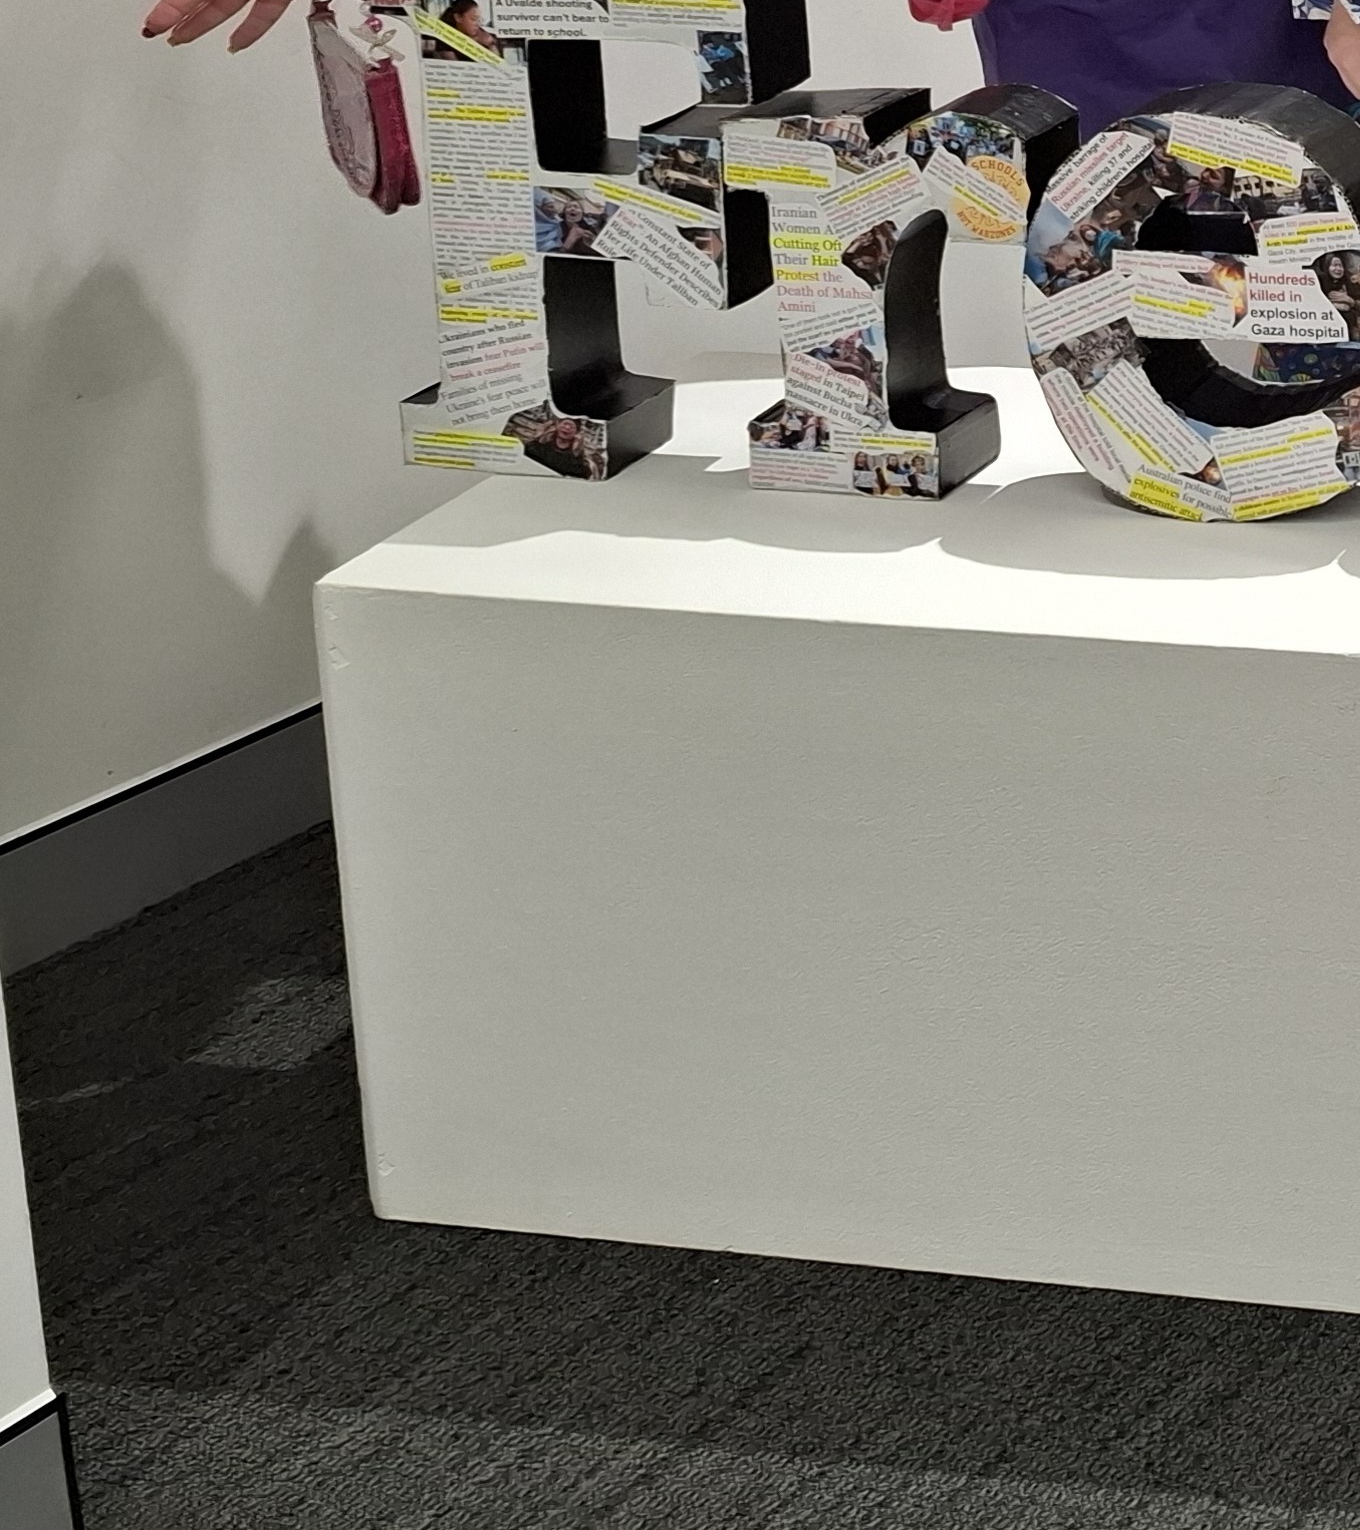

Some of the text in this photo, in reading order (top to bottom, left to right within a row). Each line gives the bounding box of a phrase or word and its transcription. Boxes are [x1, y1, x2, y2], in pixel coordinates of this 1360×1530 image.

[506, 0, 542, 7] Uvalde
[545, 0, 592, 10] shooting
[497, 14, 609, 23] survivor can't bear to
[499, 28, 530, 36] return
[534, 28, 544, 36] to
[1073, 142, 1099, 167] barrage
[1099, 134, 1108, 144] of
[1052, 132, 1129, 203] Russian missiles target
[1088, 166, 1111, 186] killing
[1108, 157, 1118, 167] 37
[1120, 144, 1133, 159] and
[971, 160, 1025, 187] SCHOOLS
[772, 207, 817, 218] Iranian
[1070, 196, 1098, 220] striking
[772, 222, 821, 234] Women
[957, 211, 1017, 239] NOT WARZONES
[637, 213, 712, 270] Constant State of
[773, 238, 820, 253] Cutting
[610, 221, 719, 308] Rights Defender Describes
[645, 233, 722, 296] An Afghan Human
[774, 254, 839, 266] Their Hair
[603, 230, 698, 306] Her Life Under Taliban
[776, 270, 843, 282] Protest the
[1248, 272, 1315, 286] Hundreds
[777, 286, 873, 299] Death of Mahsa
[1250, 290, 1302, 302] killed in
[778, 301, 815, 312] Amini
[1251, 308, 1334, 320] explosion at
[1251, 324, 1344, 340] Gaza hospital
